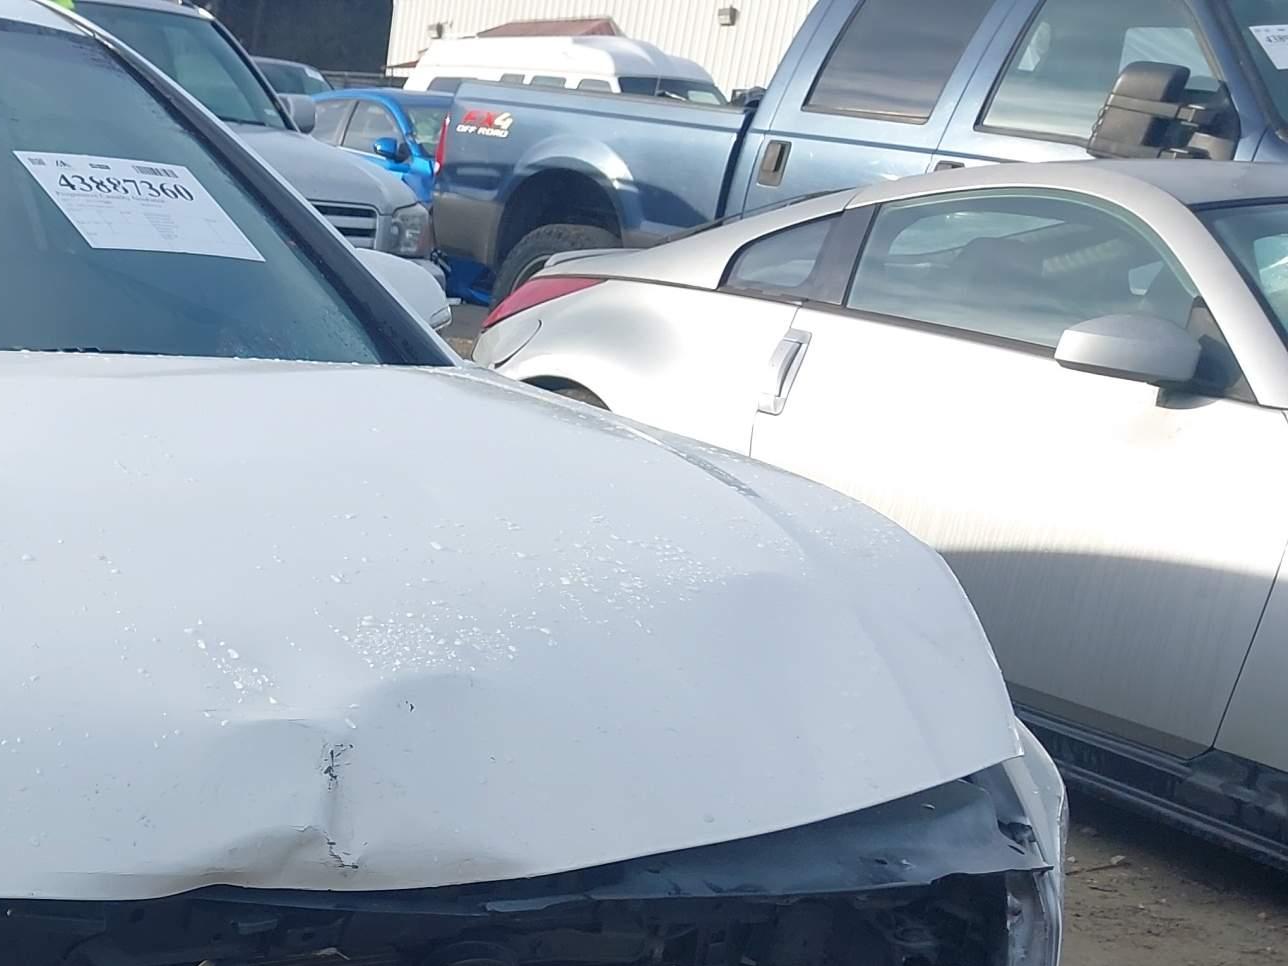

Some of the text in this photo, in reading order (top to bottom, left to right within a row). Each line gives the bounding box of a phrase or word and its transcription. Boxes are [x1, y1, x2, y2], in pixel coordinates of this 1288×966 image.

[461, 110, 514, 130] FX4
[456, 124, 509, 138] OFF ROAD
[58, 173, 194, 202] 43887360
